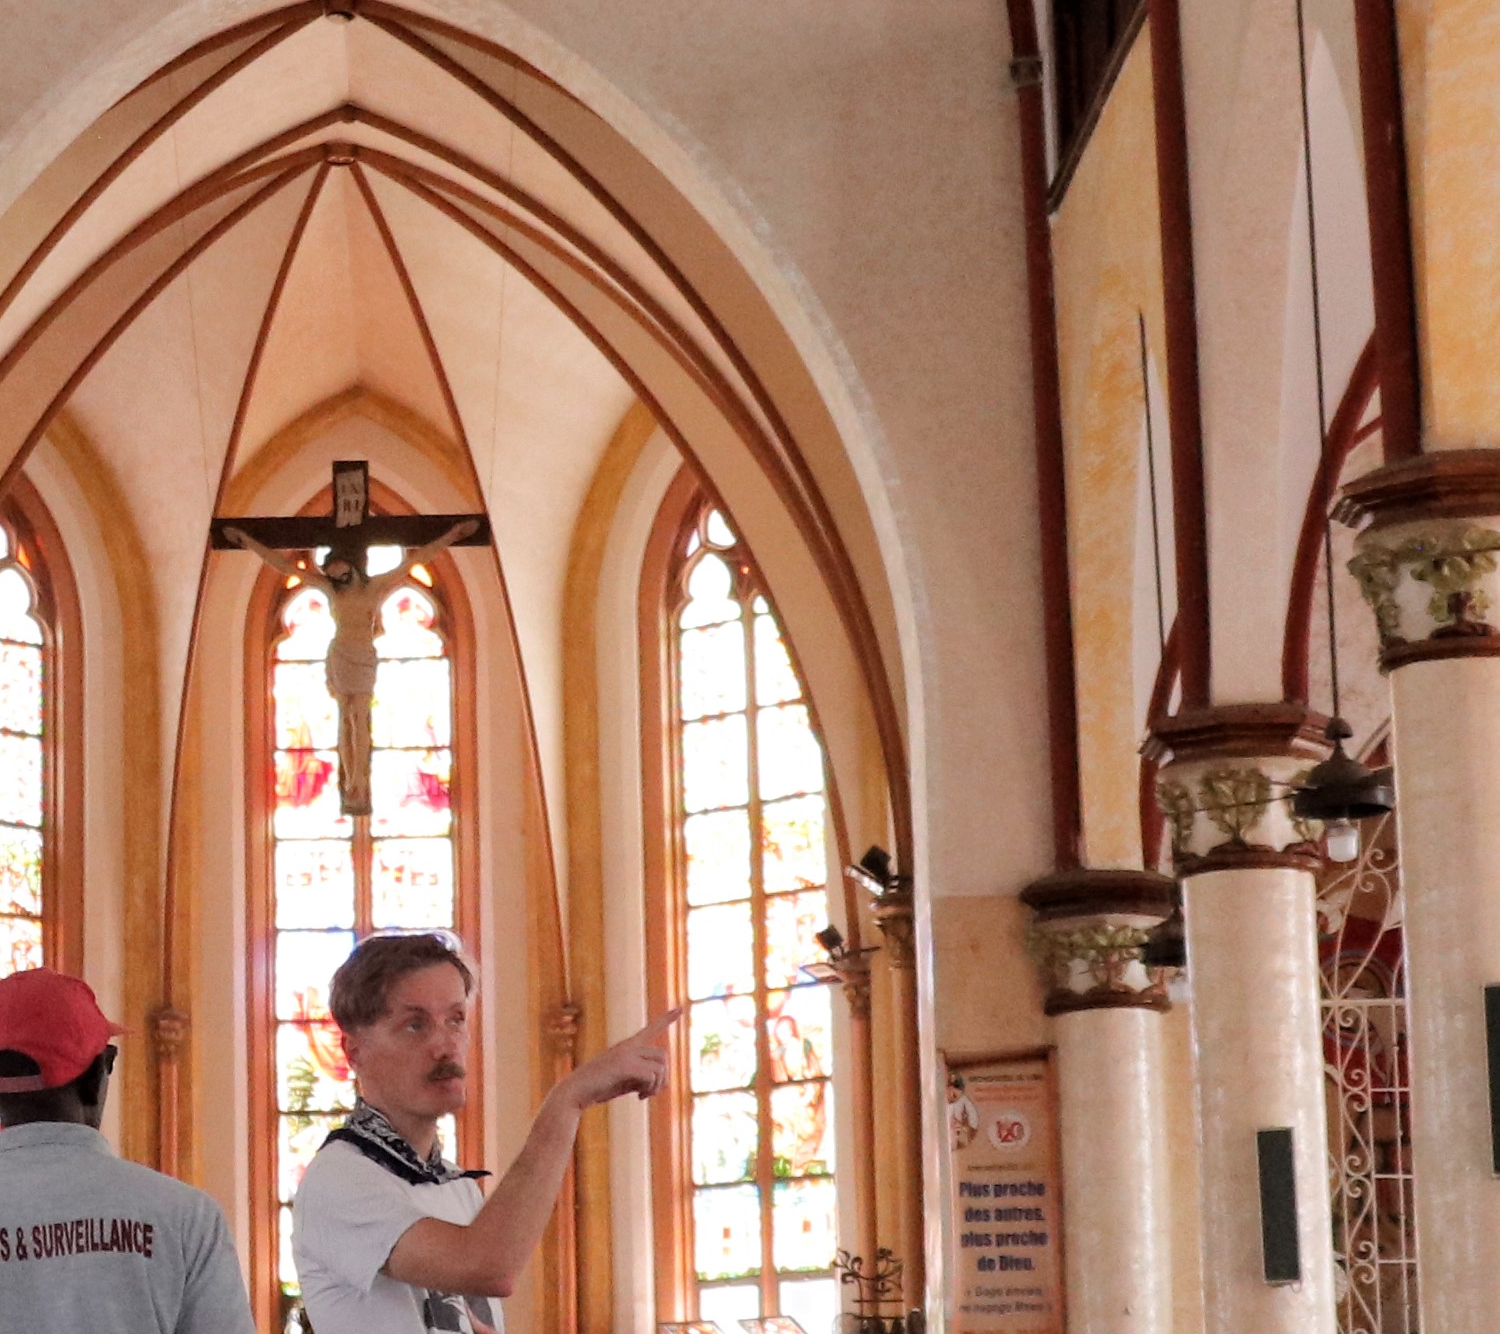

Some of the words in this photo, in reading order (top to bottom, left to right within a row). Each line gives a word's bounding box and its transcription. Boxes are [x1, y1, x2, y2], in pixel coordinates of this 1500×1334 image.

[960, 1181, 991, 1197] Plus
[993, 1180, 1045, 1198] proche
[965, 1208, 991, 1222] des
[16, 1226, 28, 1261] &
[32, 1218, 154, 1259] SURVEILLANCE
[960, 1232, 992, 1248] plus
[995, 1231, 1048, 1247] proche
[977, 1256, 996, 1272] de
